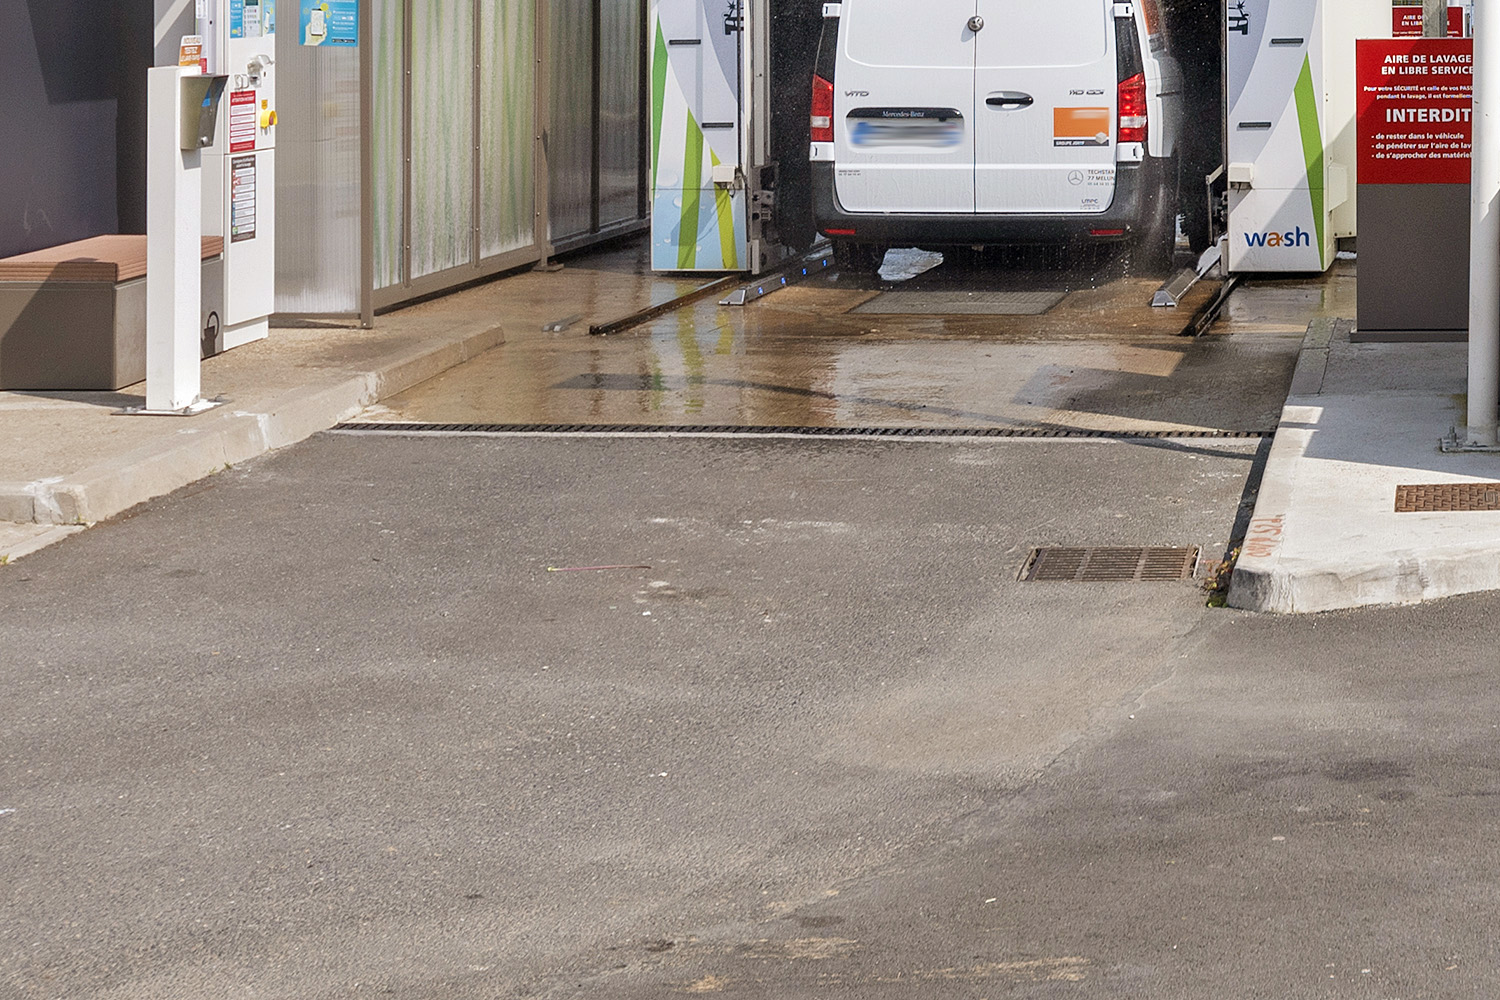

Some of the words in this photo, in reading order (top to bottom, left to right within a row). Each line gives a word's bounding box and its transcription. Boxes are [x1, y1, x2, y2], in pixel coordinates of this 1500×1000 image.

[1384, 55, 1409, 63] AIRE
[1412, 55, 1427, 63] DE
[1430, 54, 1472, 63] LAVAGE
[1381, 66, 1395, 75] EN
[1399, 66, 1428, 74] LIBRE
[1431, 66, 1474, 74] SERVICE
[882, 110, 925, 118] Mercedes-Benz
[1386, 108, 1472, 122] INTERDIT
[1386, 142, 1416, 150] pénétrer
[1243, 225, 1310, 247] wash
